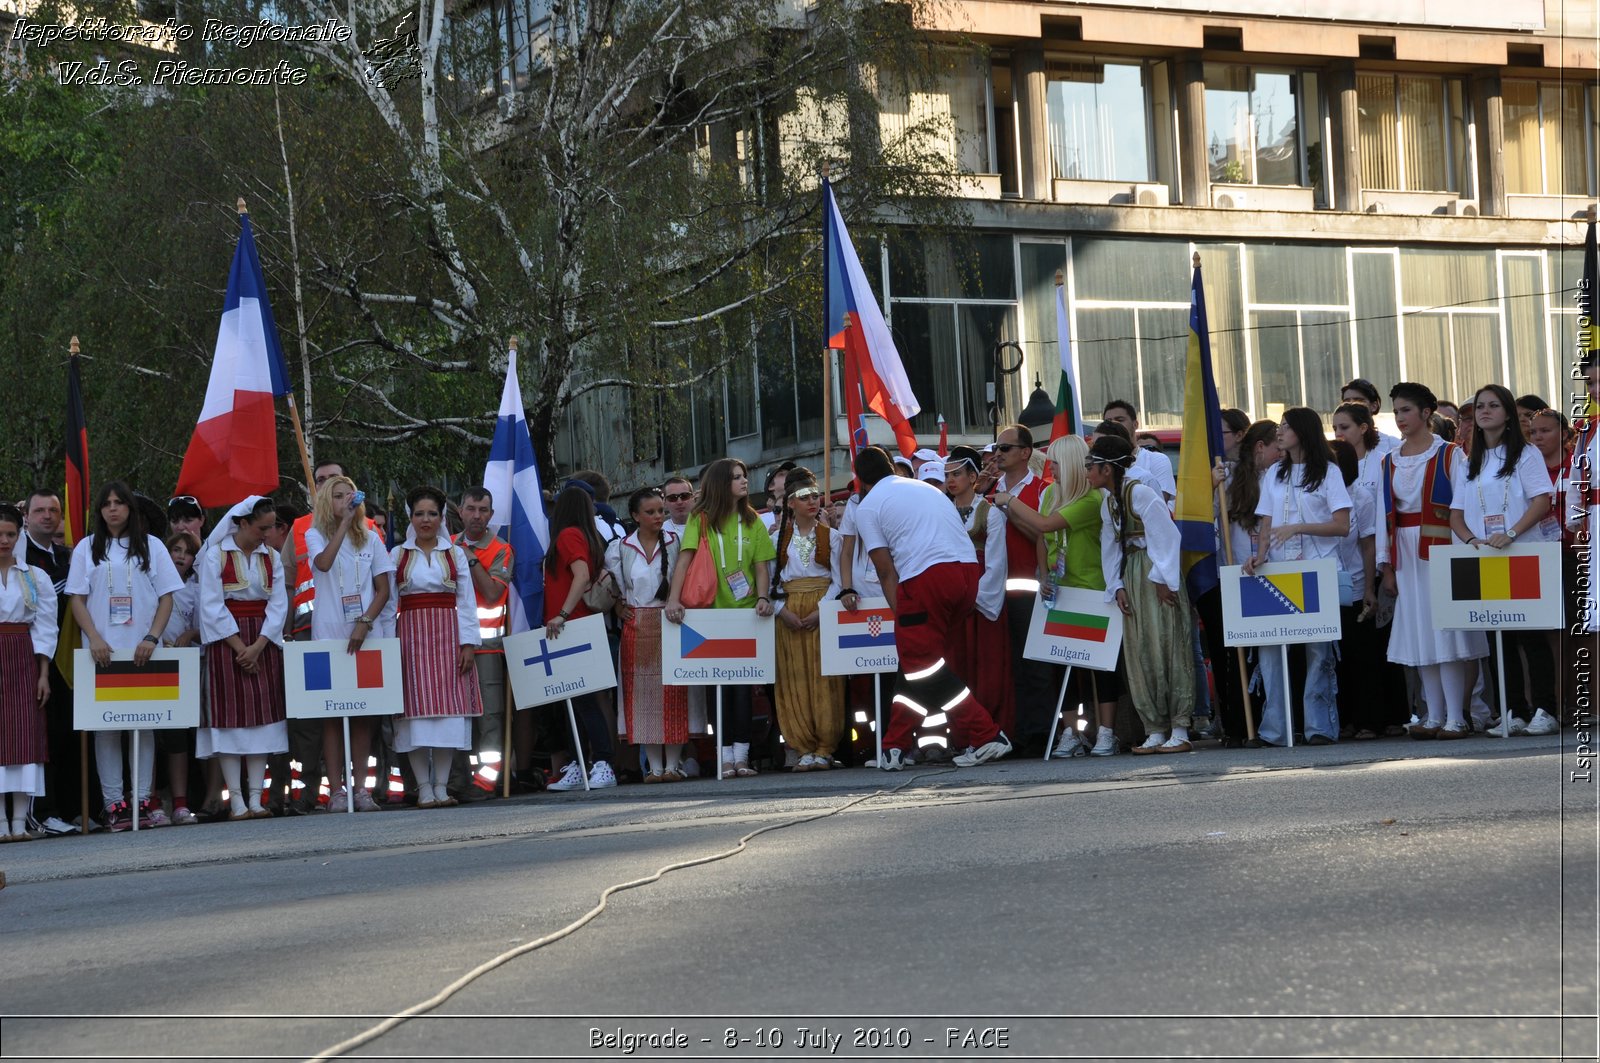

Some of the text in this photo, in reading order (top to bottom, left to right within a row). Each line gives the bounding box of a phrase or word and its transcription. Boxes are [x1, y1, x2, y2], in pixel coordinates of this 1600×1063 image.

[1469, 609, 1526, 626] Belgium
[1227, 624, 1338, 640] Bosnia and Herzegovina
[1050, 645, 1091, 661] Bulgaria
[855, 654, 898, 668] Croatia
[673, 666, 764, 680] Czech Republic
[544, 676, 586, 697] Finland
[325, 699, 367, 711] France
[102, 709, 174, 724] Germany I
